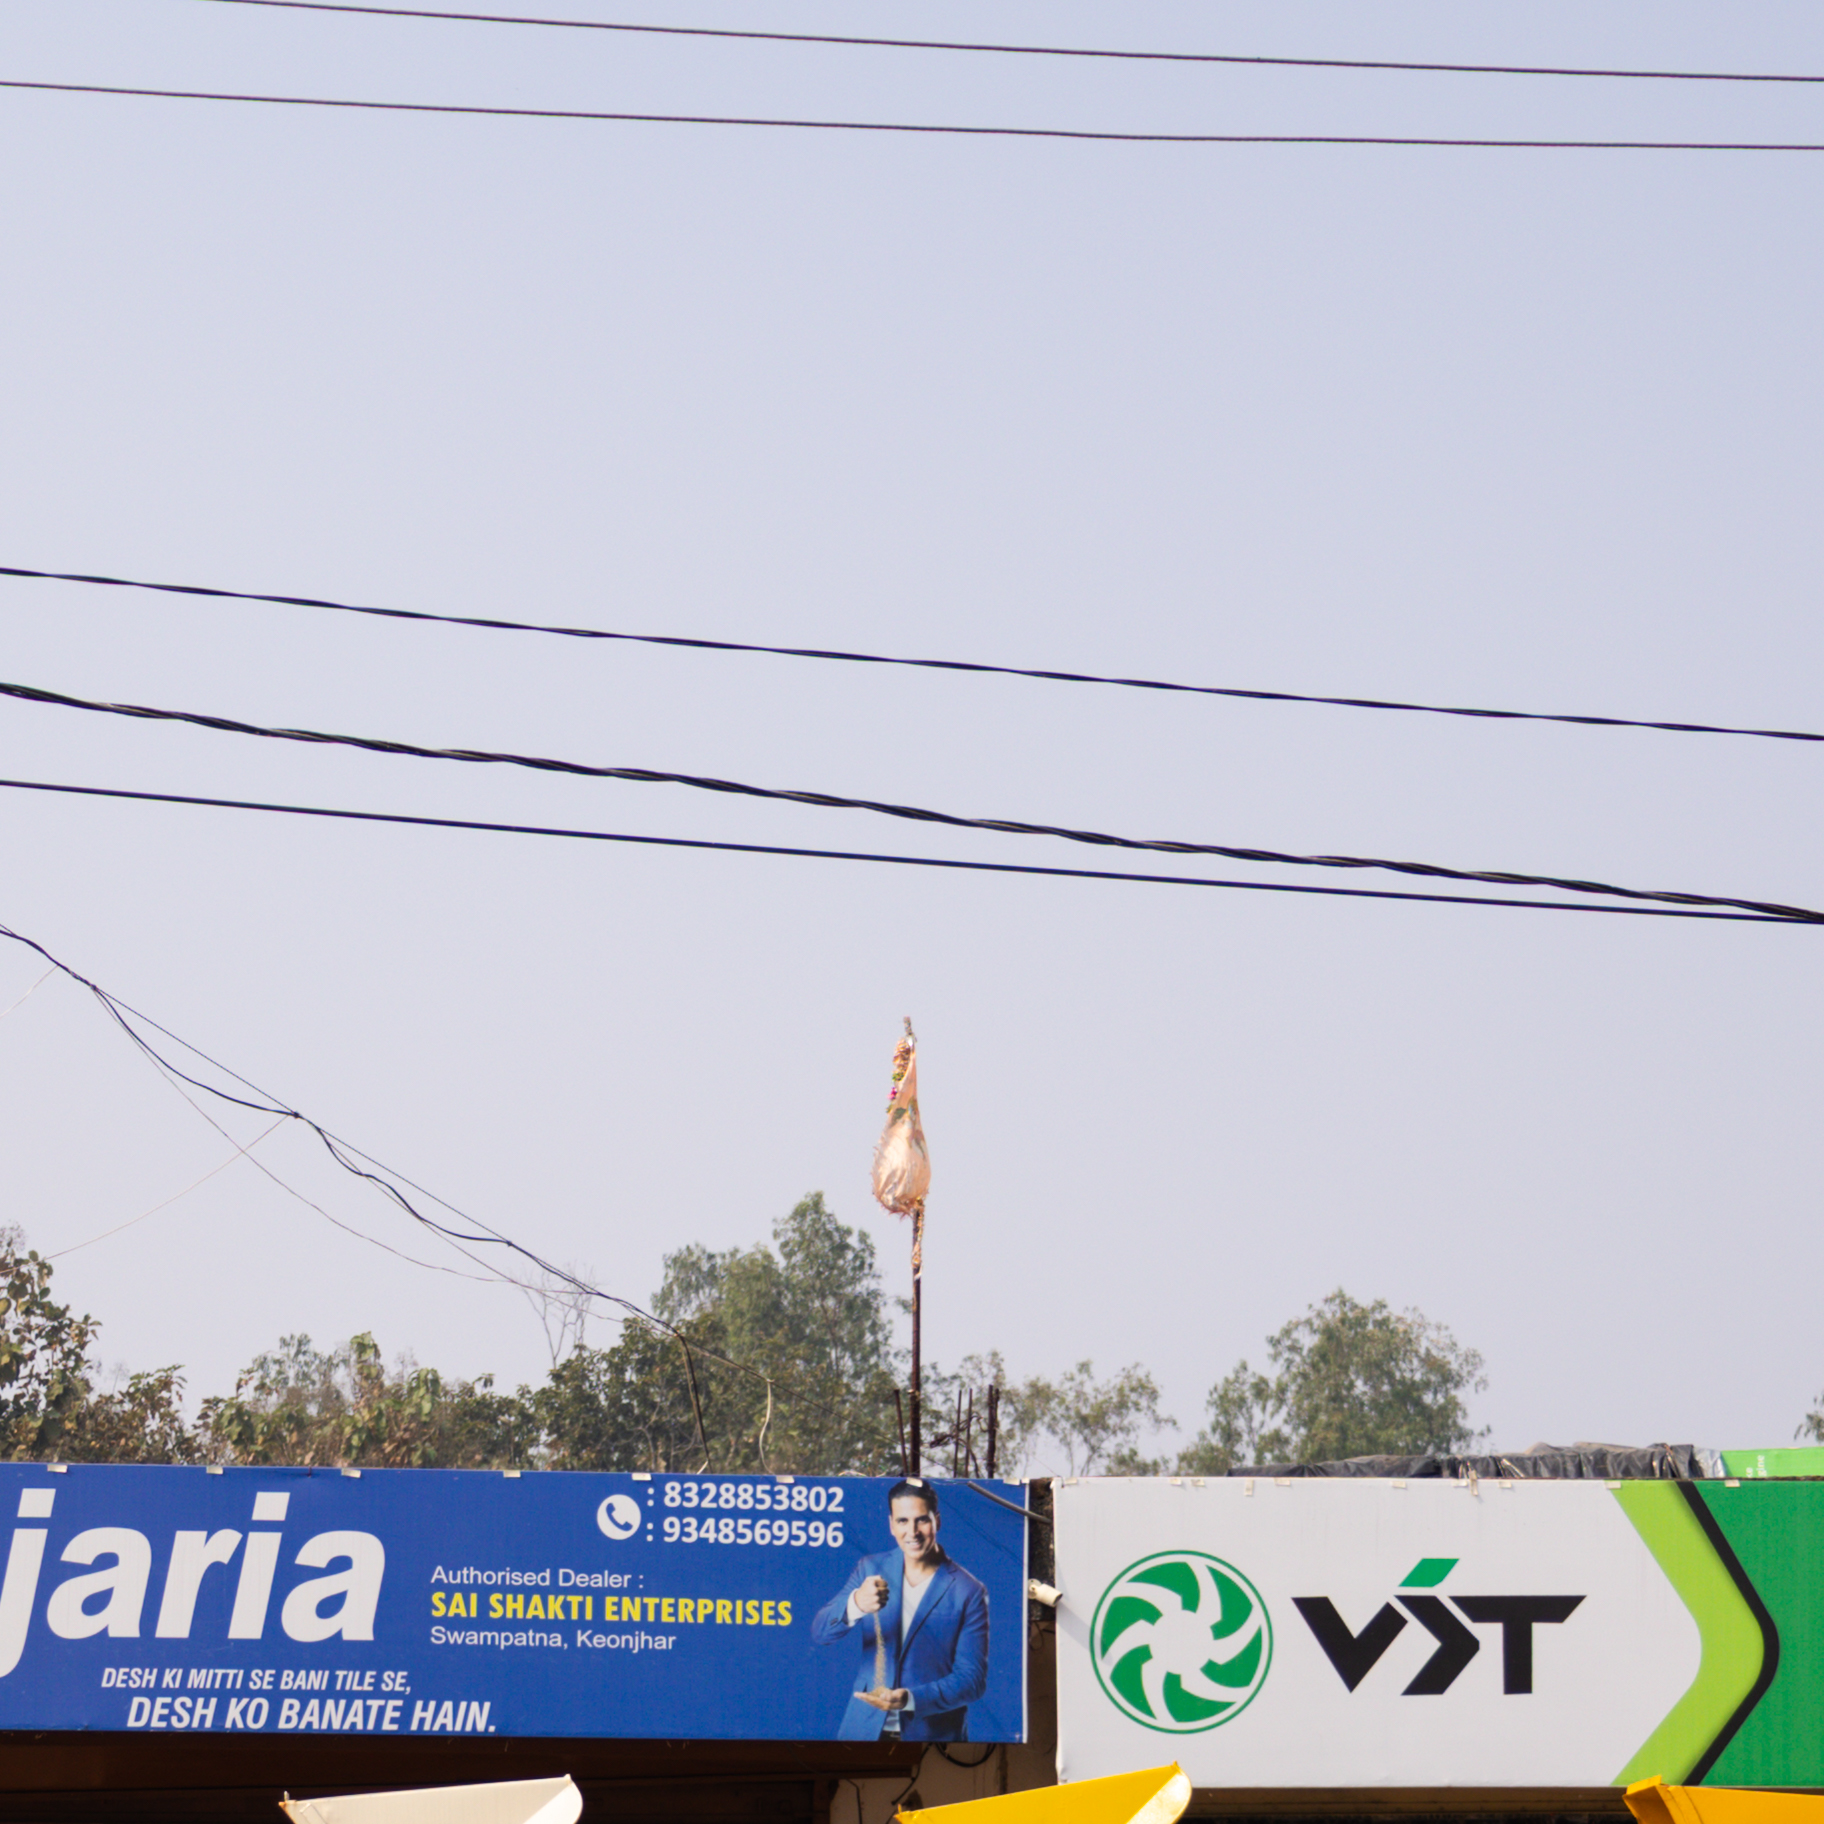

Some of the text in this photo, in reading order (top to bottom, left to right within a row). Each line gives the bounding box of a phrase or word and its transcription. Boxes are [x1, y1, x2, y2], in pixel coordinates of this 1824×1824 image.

[663, 1481, 845, 1513] 8328853802
[662, 1517, 845, 1548] 9348569596
[430, 1565, 632, 1589] Authorised Dealer
[430, 1592, 793, 1626] SAI SHAKTI ENTERPRISES
[430, 1625, 676, 1651] Swampatna, Keonjhar
[1291, 1558, 1587, 1696] VST
[101, 1667, 411, 1694] DESH KI MITTI SE BANI TILE SE,
[126, 1696, 496, 1733] DESH KO BANATE HAIN.
